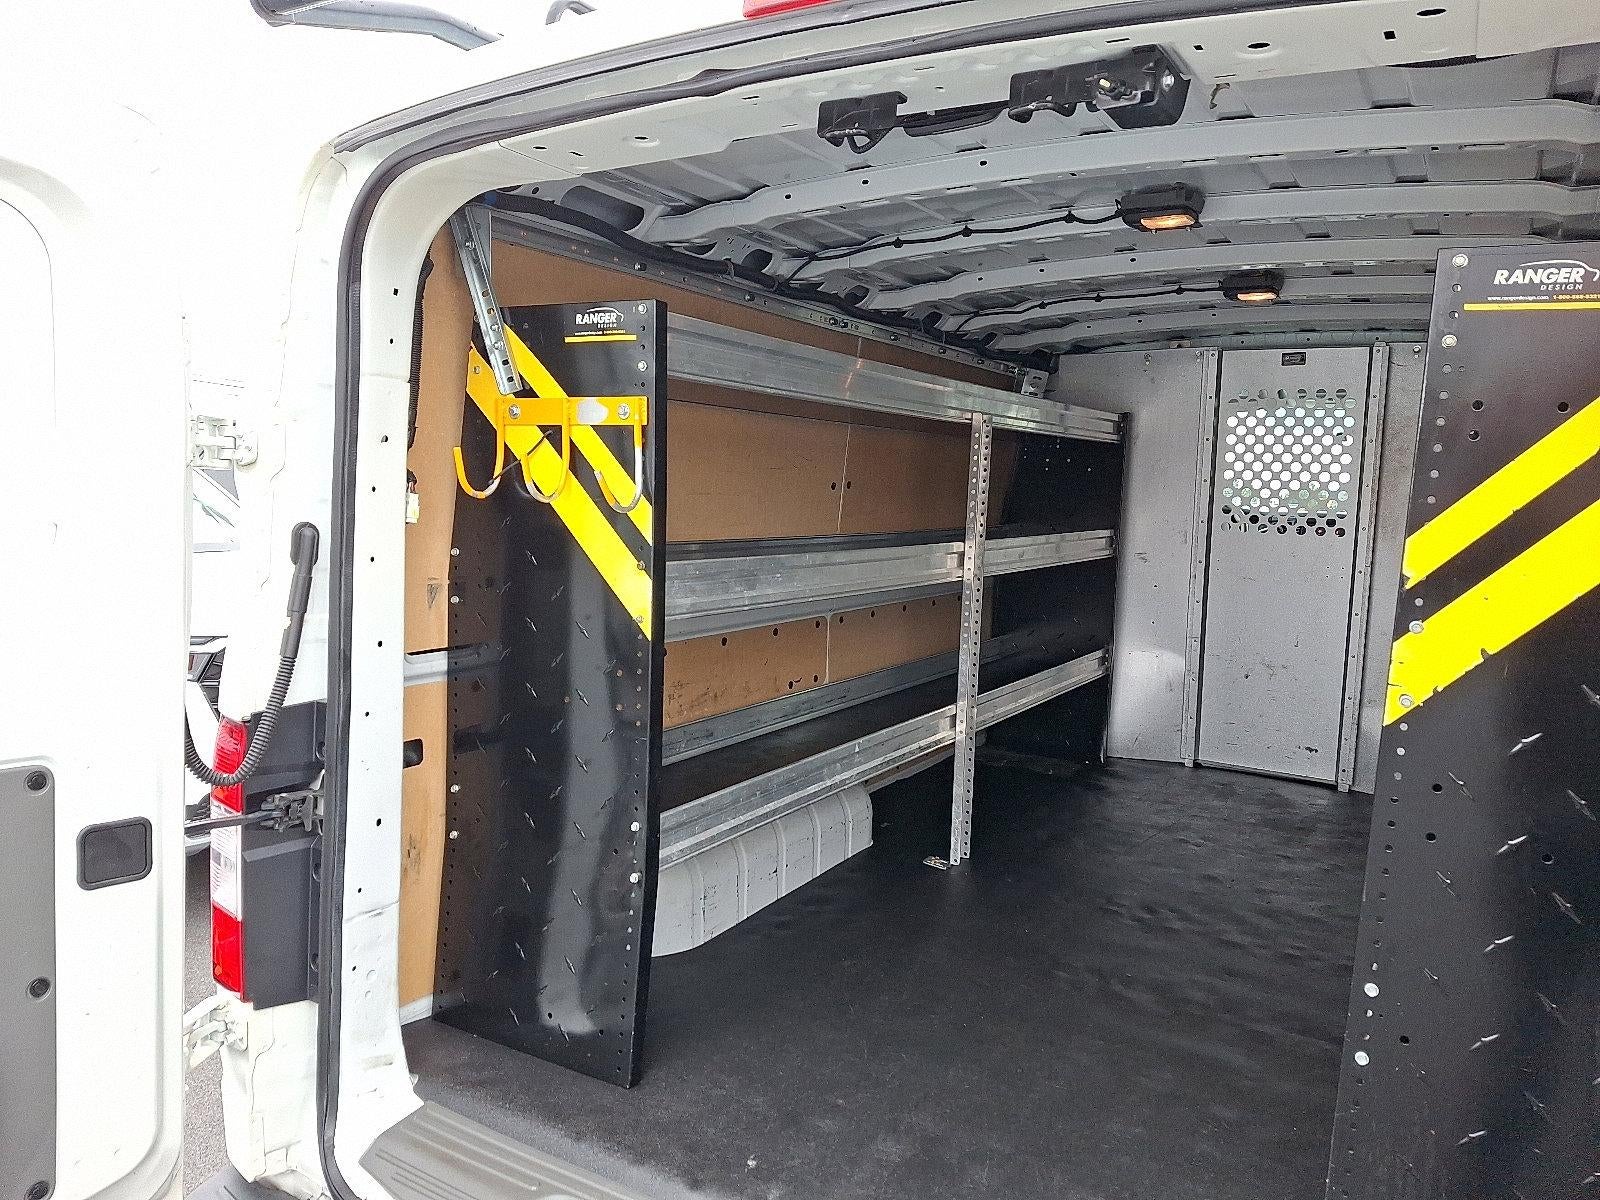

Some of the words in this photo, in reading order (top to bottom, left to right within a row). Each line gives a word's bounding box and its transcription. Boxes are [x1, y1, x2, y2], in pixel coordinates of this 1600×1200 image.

[1493, 267, 1585, 285] RANGER
[1540, 283, 1583, 291] DESIGN
[575, 312, 617, 325] RANGER
